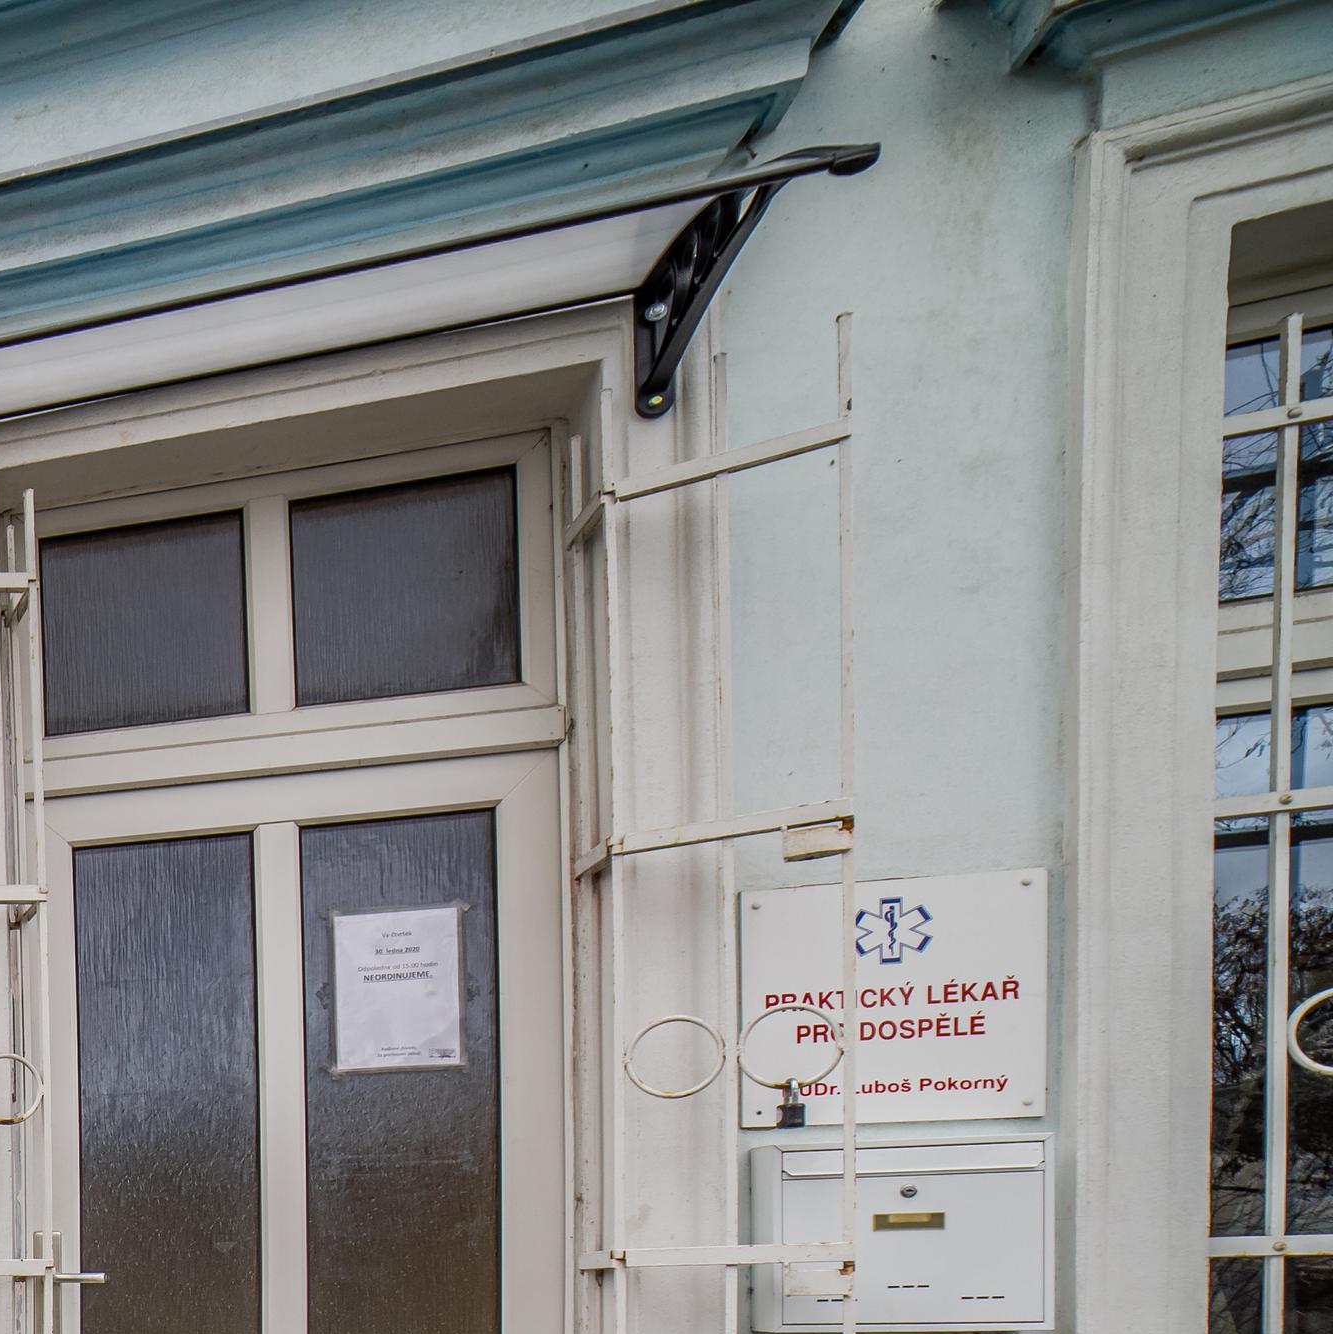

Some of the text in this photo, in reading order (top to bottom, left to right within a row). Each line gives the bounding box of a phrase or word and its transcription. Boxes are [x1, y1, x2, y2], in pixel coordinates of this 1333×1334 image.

[927, 974, 1020, 1005] LÉKAŘ
[860, 1010, 986, 1041] DOSPĚLÉ
[855, 1077, 912, 1095] uboš
[919, 1074, 1009, 1093] Pokorný
